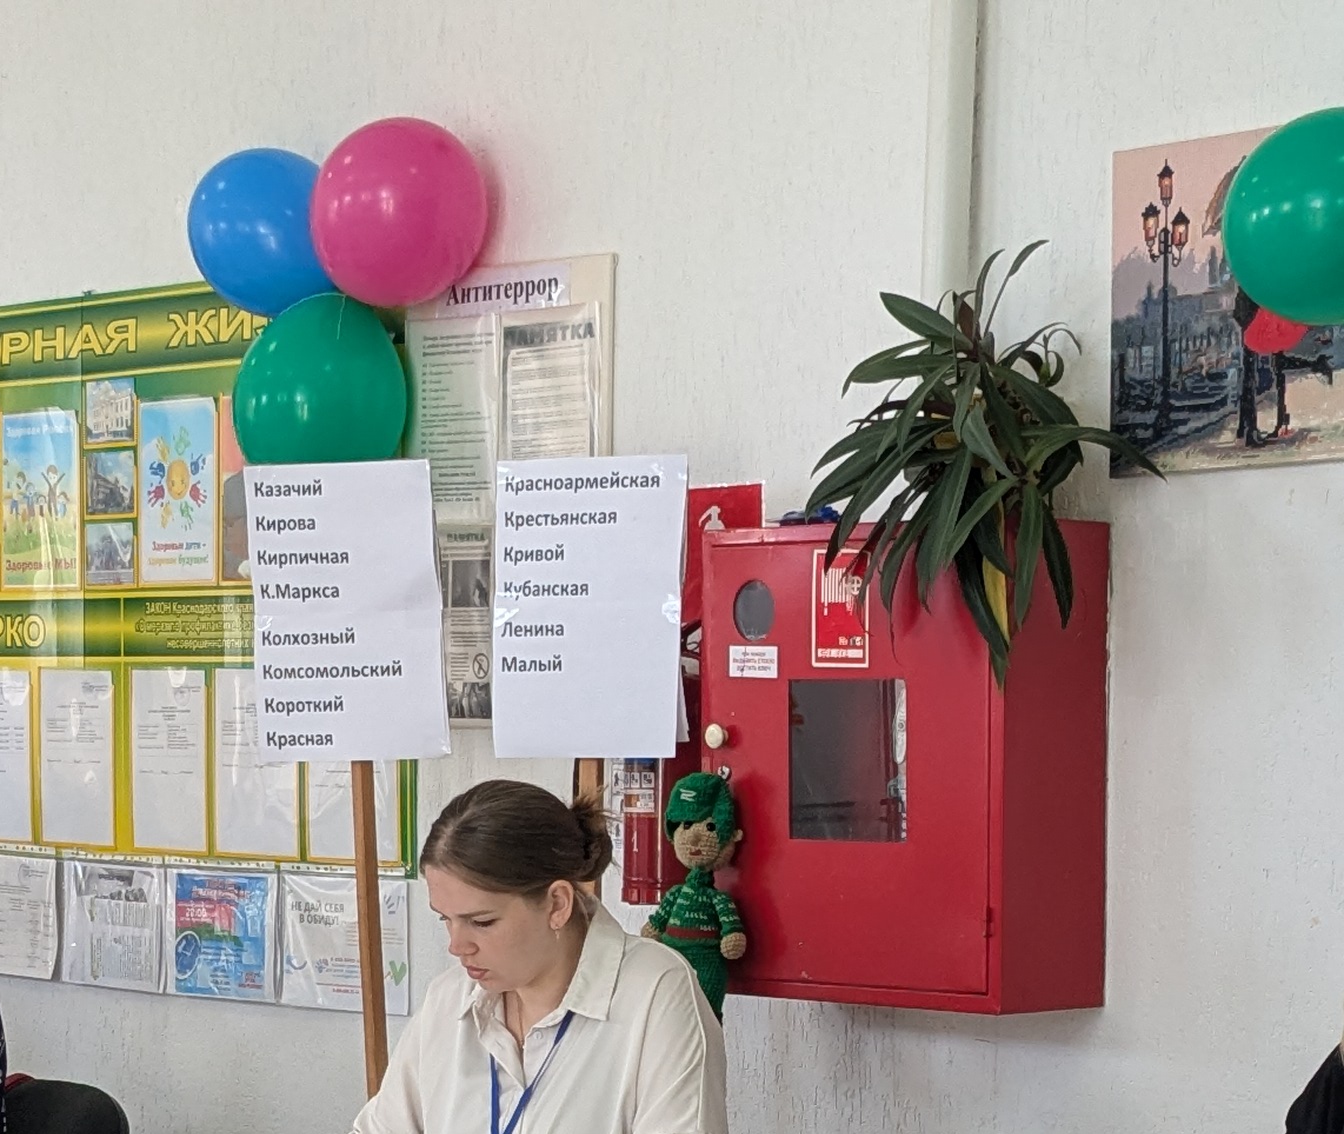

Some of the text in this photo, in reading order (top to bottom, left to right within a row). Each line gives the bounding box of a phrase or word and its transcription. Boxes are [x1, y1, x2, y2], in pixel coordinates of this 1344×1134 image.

[446, 276, 559, 306] Антитеррор
[254, 480, 323, 497] Казачий
[505, 472, 661, 495] Красноармейская
[256, 516, 316, 534] Кирова
[504, 510, 618, 531] Крестьянская
[257, 550, 350, 569] Кирпичная
[503, 544, 565, 566] Кривой
[260, 584, 340, 603] К.Маркса
[504, 580, 589, 601] Кубанская
[262, 628, 356, 646] Колхозный
[501, 622, 565, 638] Ленина
[262, 660, 403, 680] Комсомольский
[501, 654, 563, 673] Малый
[264, 696, 344, 715] Короткий
[266, 731, 334, 749] Красная
[291, 901, 345, 914] НЕ ДАЙ СЕБЯ
[299, 914, 306, 924] В
